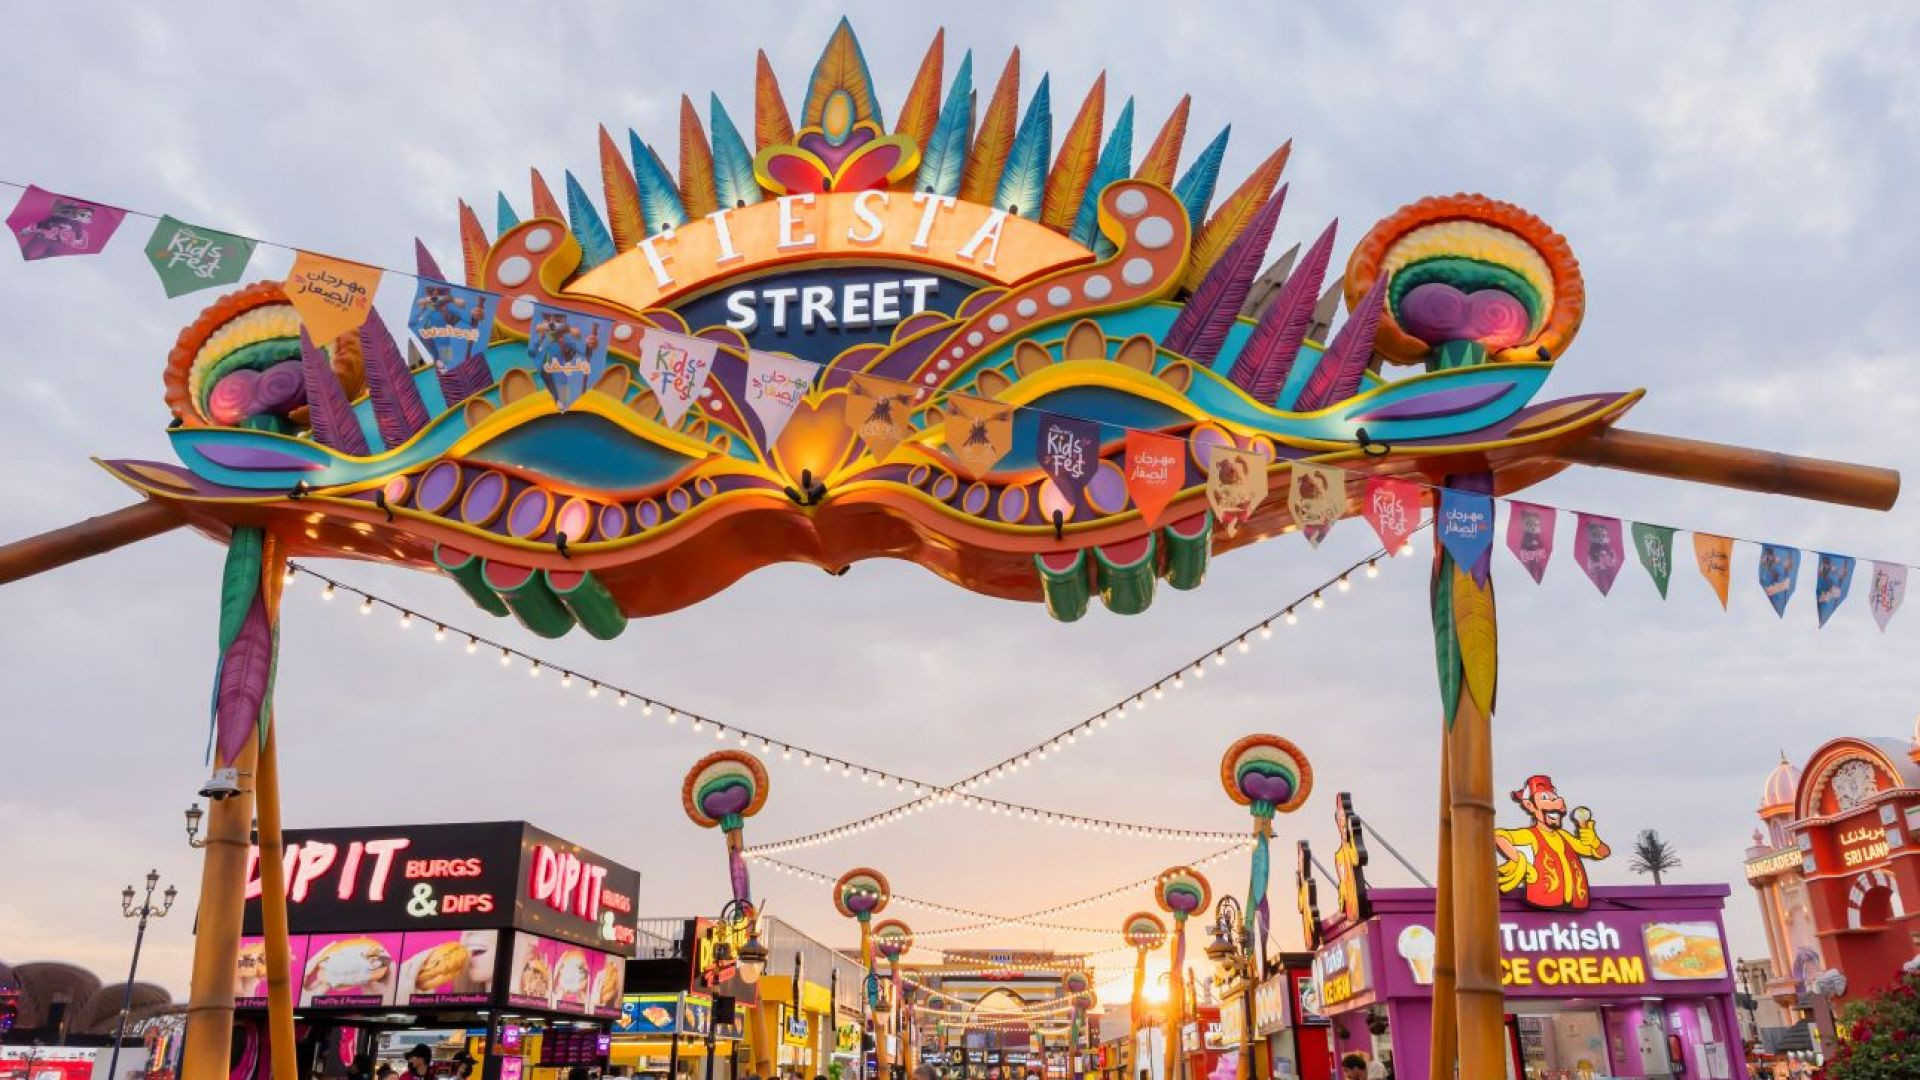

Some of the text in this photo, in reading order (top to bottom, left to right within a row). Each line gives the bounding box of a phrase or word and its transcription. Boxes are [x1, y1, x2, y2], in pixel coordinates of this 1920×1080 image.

[167, 231, 223, 259] Kids
[637, 189, 1010, 288] FIESTA
[168, 251, 220, 278] Fest
[297, 281, 354, 307] الصغار
[307, 269, 366, 295] مهرجان
[726, 278, 940, 332] STREET
[656, 348, 696, 376] Kids
[661, 371, 696, 401] Fest
[1047, 431, 1083, 458] Kids
[1052, 452, 1086, 478] Fest
[1130, 464, 1168, 481] الصغار
[1134, 451, 1175, 468] مهرجان
[1373, 491, 1405, 517] Kids
[1446, 508, 1484, 522] مهرجان
[1379, 511, 1408, 536] Fest
[1444, 519, 1477, 535] الصغار
[338, 838, 412, 901] IT
[405, 858, 482, 878] BURGS
[1745, 850, 1802, 879] BANGLADESH
[1844, 848, 1863, 868] SRI
[530, 845, 608, 921] DIP IT
[406, 882, 494, 918] & DIPS
[1499, 919, 1620, 952] Turkish
[1499, 955, 1646, 986] CE CREAM
